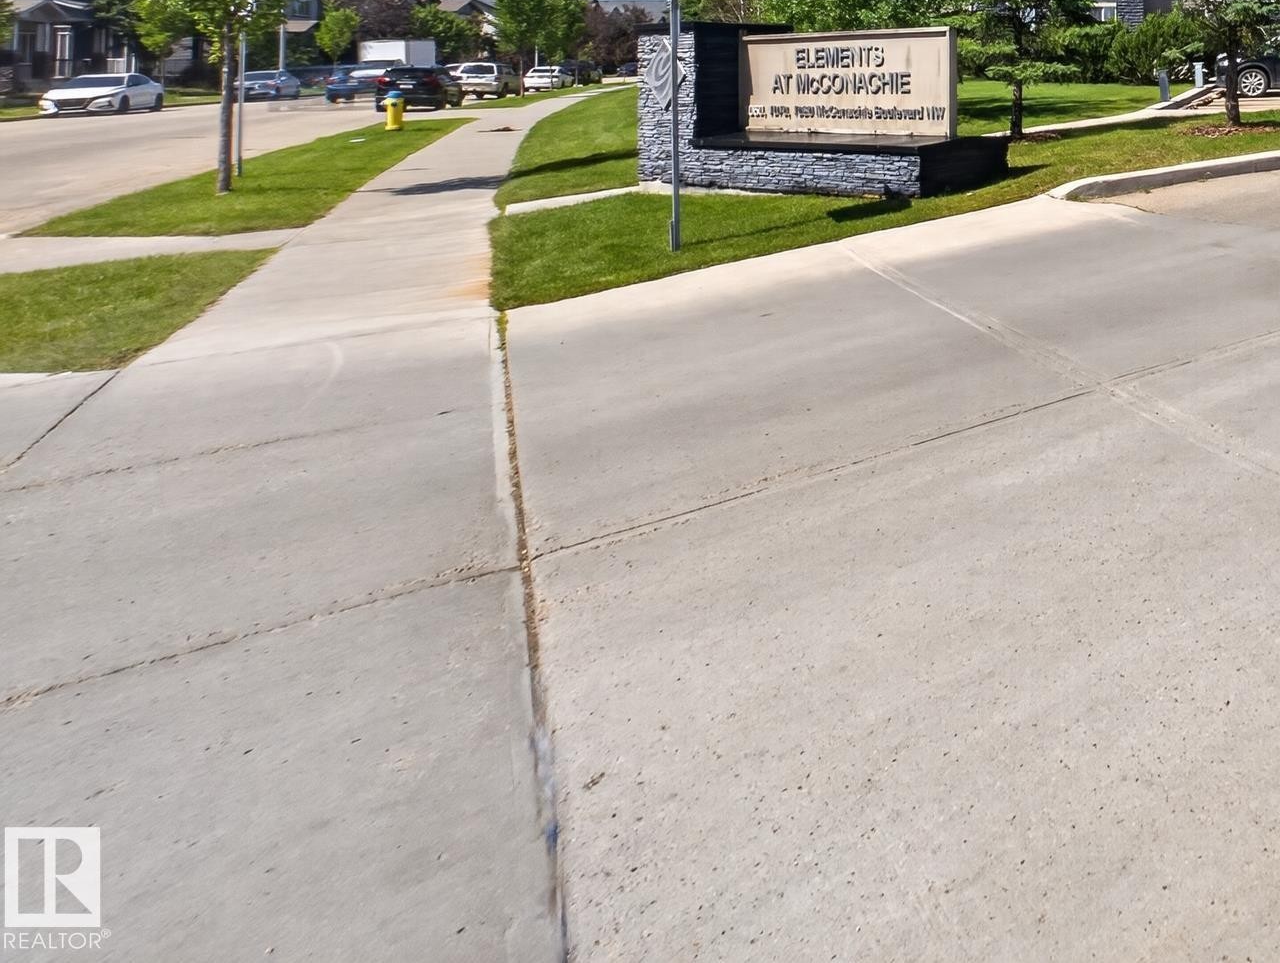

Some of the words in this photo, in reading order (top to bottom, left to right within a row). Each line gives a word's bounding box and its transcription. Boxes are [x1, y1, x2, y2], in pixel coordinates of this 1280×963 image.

[795, 46, 885, 69] ELEMENTS
[772, 73, 793, 95] AT
[795, 71, 912, 95] McCONACHIE
[874, 105, 925, 121] Boulevard
